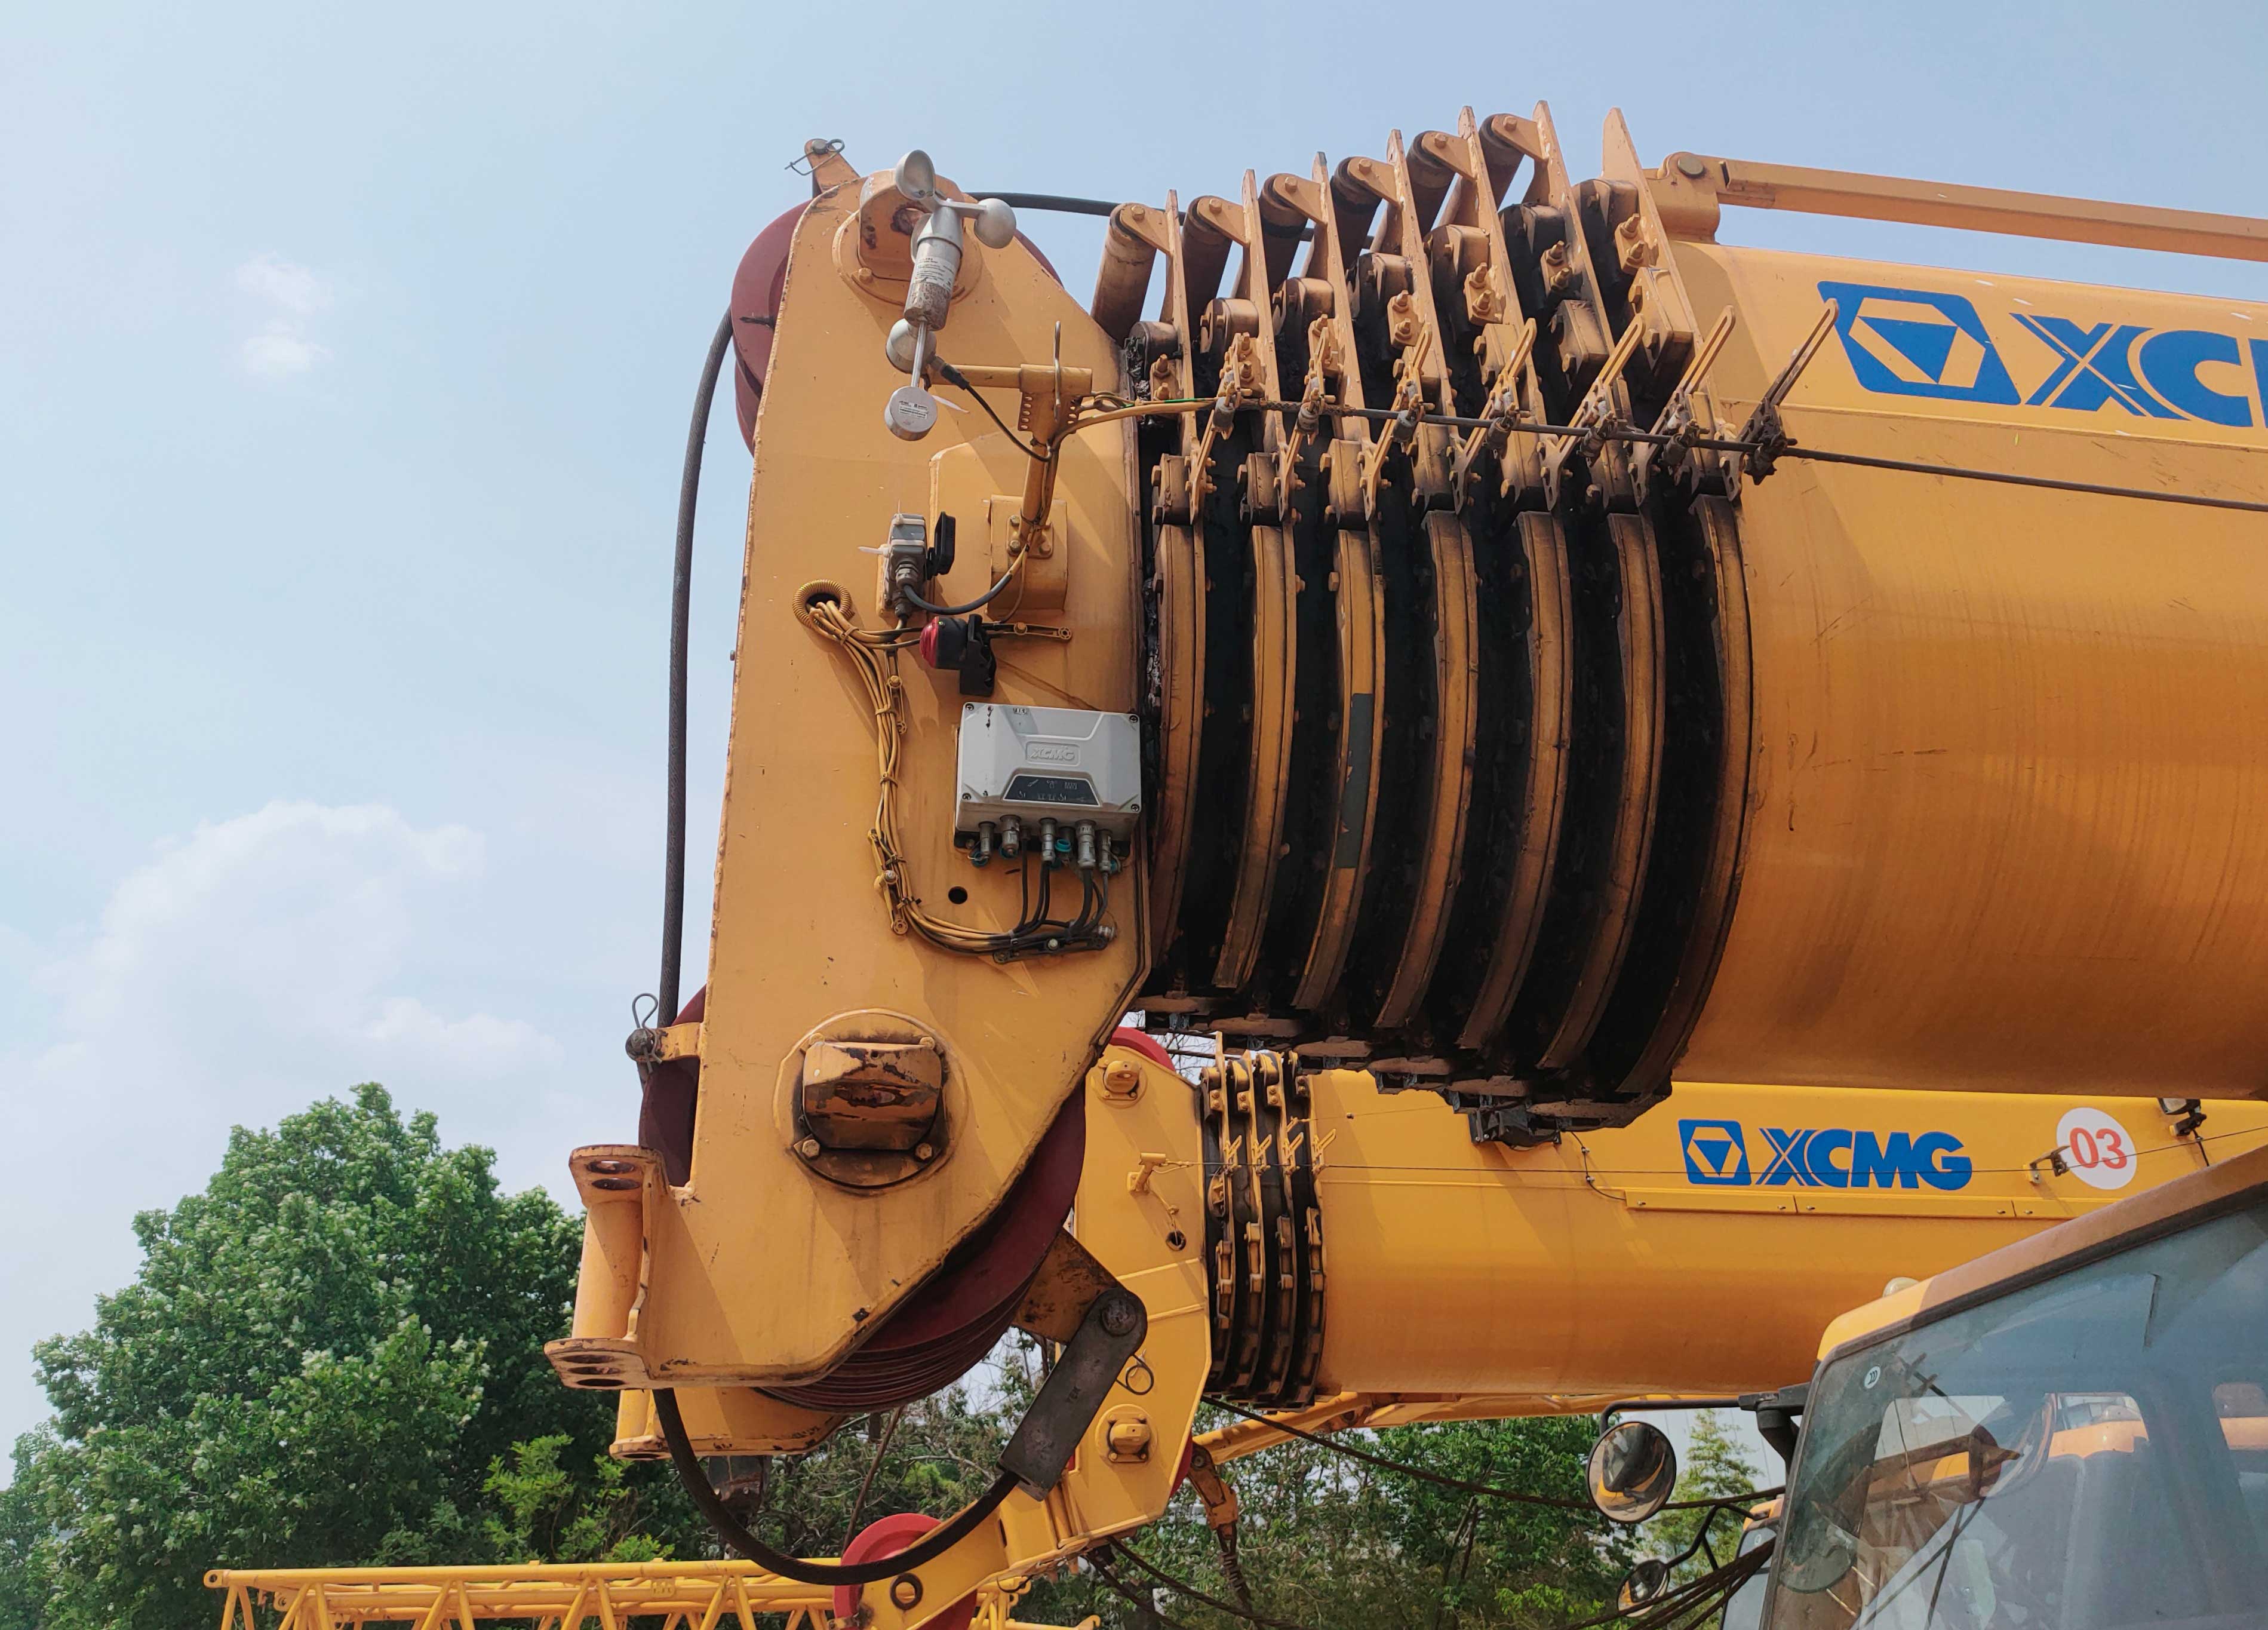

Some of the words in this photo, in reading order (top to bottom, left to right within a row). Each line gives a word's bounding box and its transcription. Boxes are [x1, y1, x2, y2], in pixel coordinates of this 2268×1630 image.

[2009, 313, 2268, 427] XC
[1029, 746, 1075, 761] XCMG
[1757, 1128, 1972, 1190] XCMG
[2069, 1127, 2127, 1169] 03
